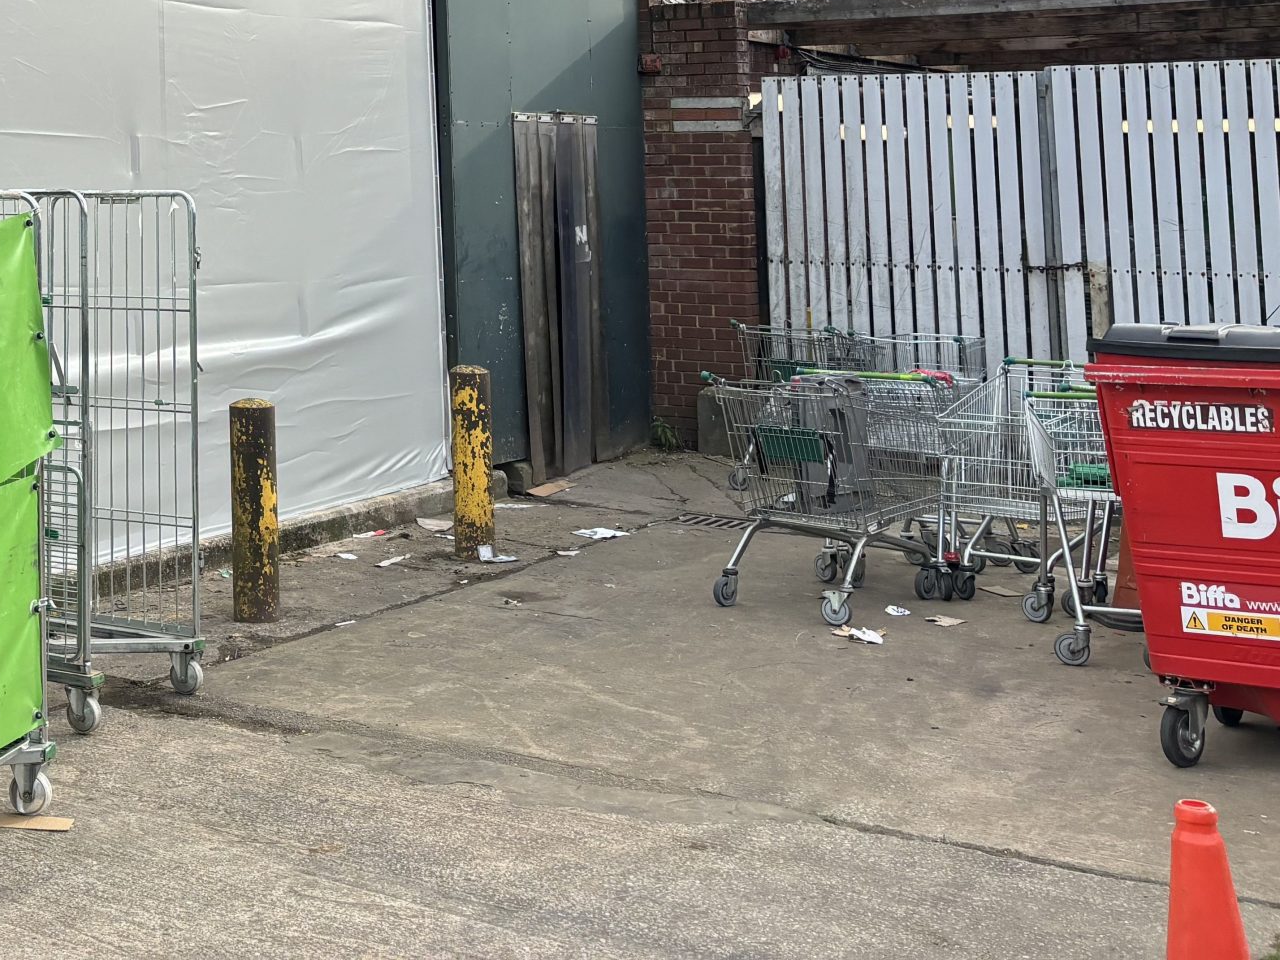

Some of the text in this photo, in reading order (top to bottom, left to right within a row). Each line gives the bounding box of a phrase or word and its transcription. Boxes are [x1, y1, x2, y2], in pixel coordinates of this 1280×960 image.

[1132, 403, 1271, 433] RECYCLABLES
[1180, 581, 1241, 609] Biffa
[1221, 623, 1267, 634] OF DEATH
[1224, 615, 1263, 626] DANGER
